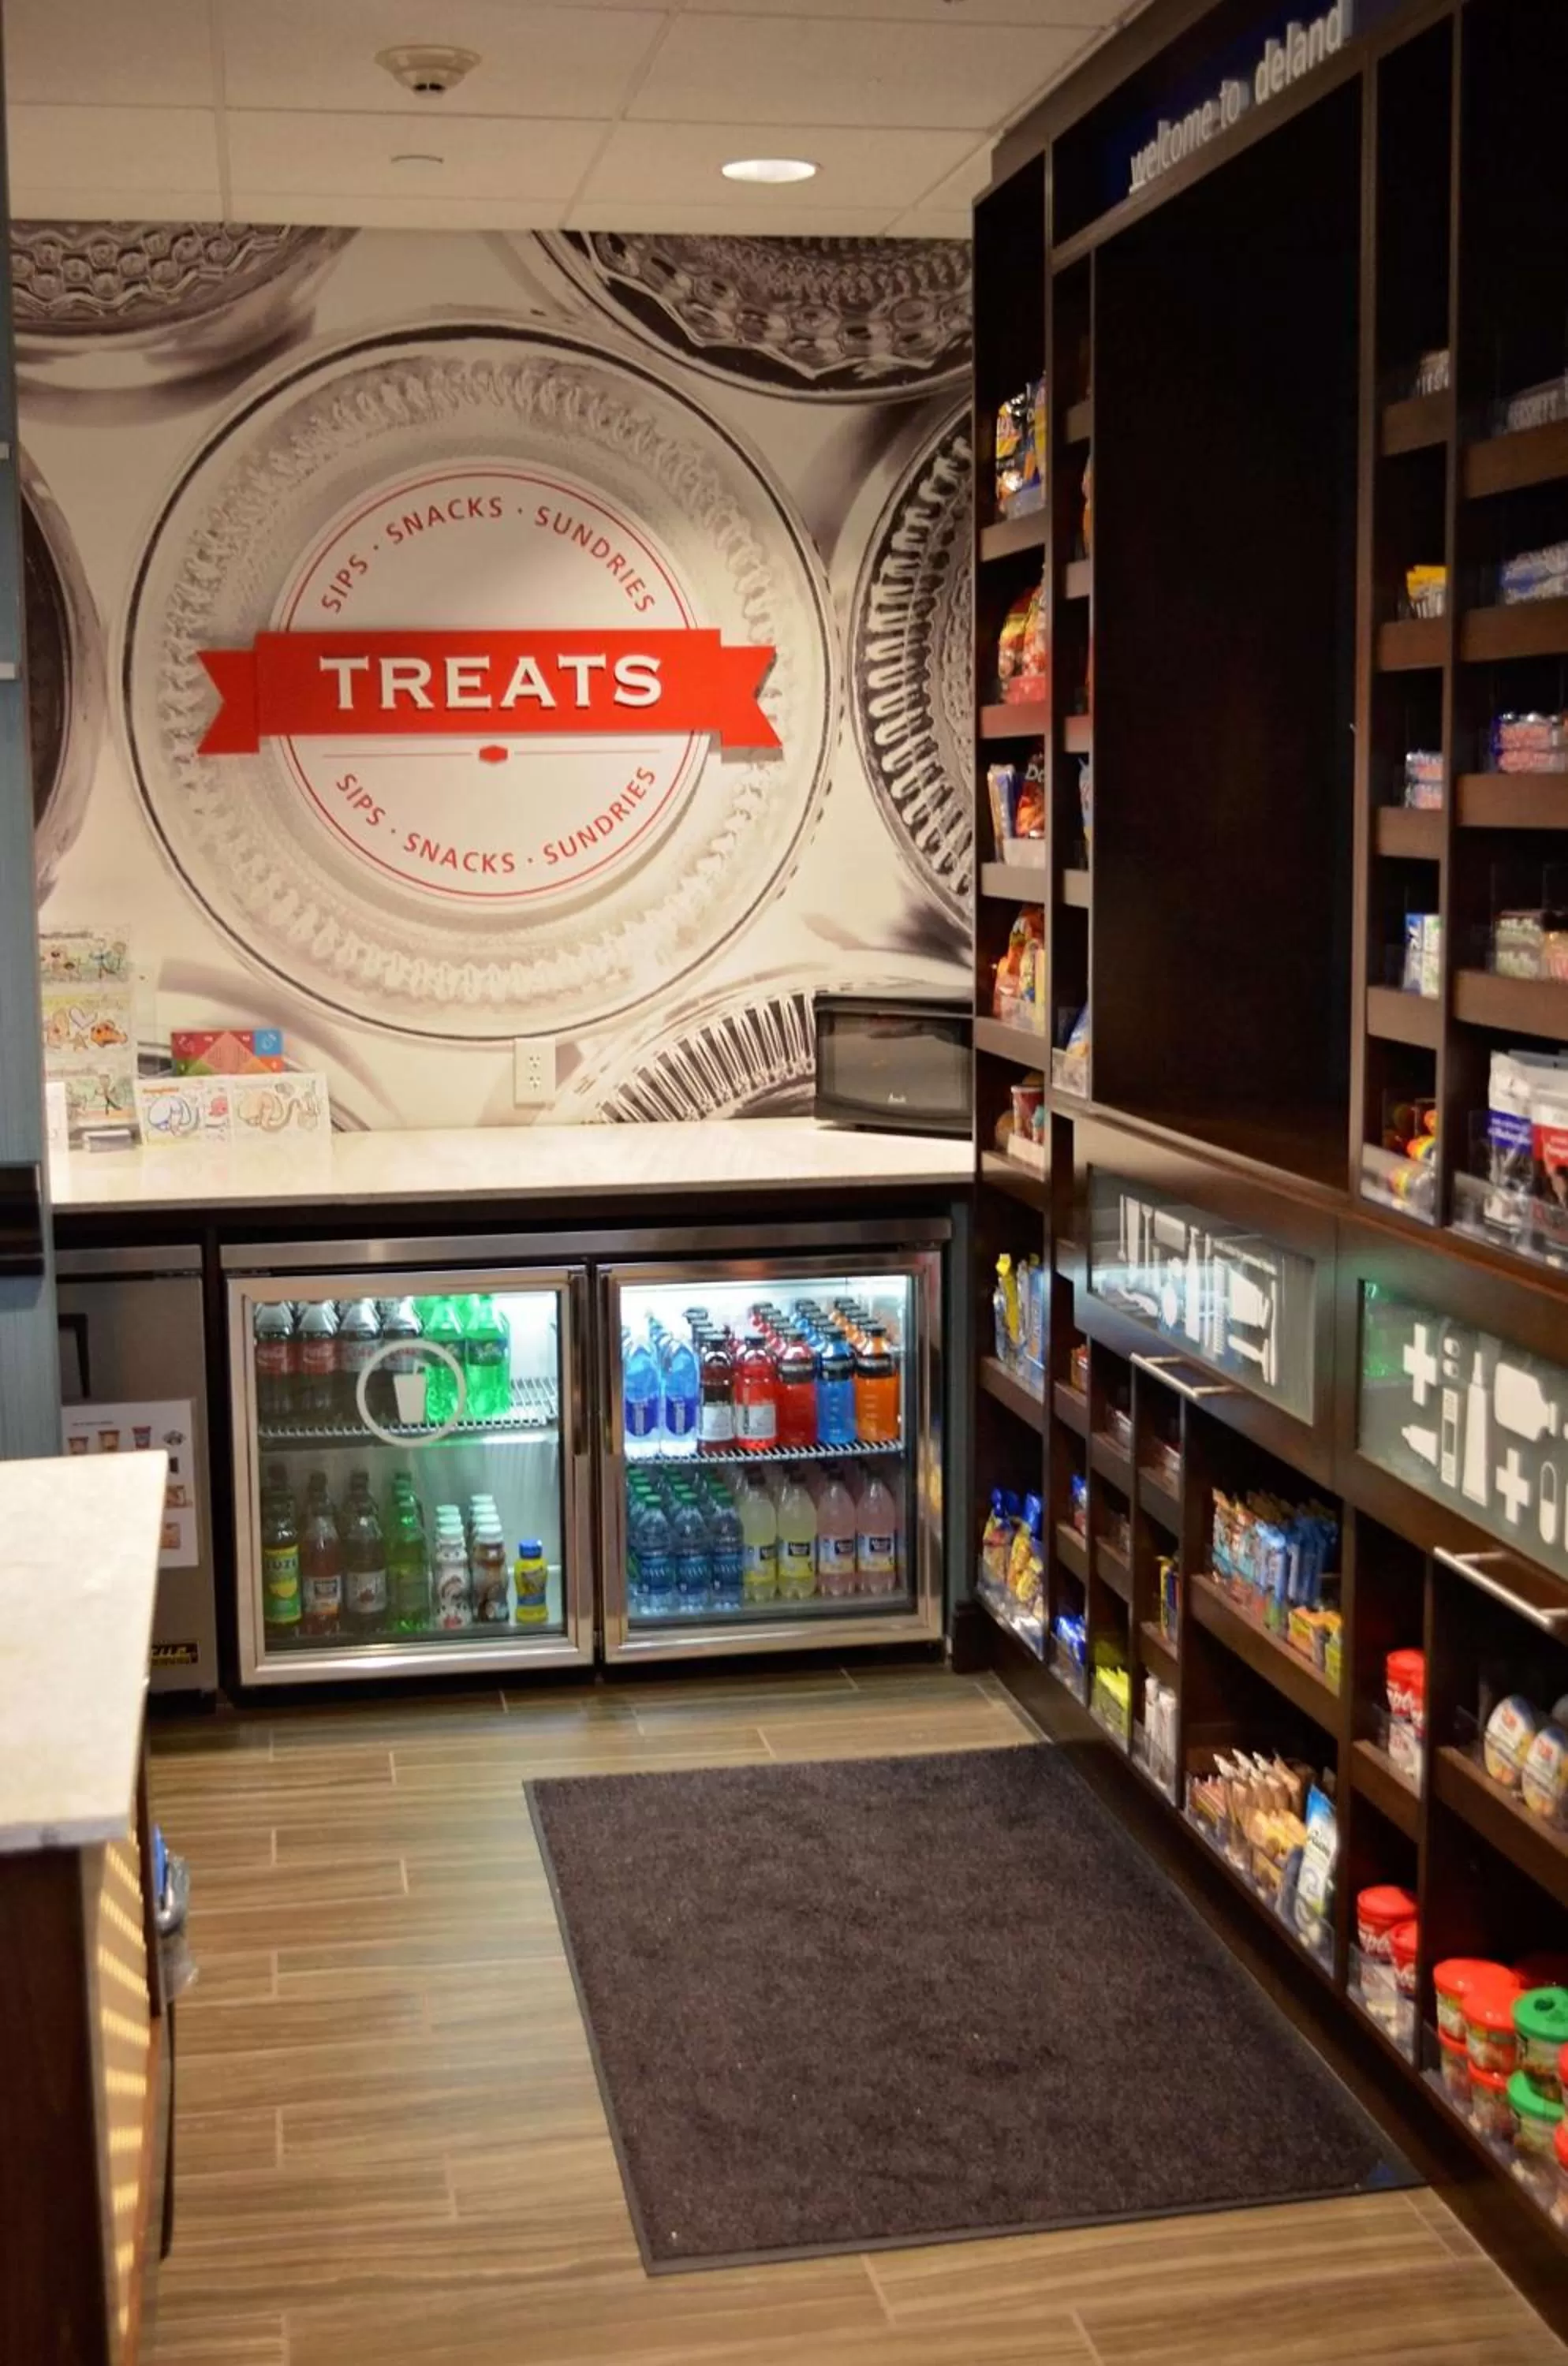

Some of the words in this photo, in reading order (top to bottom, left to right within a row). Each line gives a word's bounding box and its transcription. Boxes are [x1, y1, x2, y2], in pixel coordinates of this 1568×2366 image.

[1129, 99, 1216, 185] welcome
[1219, 80, 1244, 130] to
[321, 554, 368, 614] SIPS
[385, 496, 503, 545] SNACKS
[533, 505, 655, 613] SUNDRIES
[319, 653, 663, 710] TREATS
[335, 773, 386, 827] SIPS
[402, 832, 516, 875] SNACKS
[543, 766, 656, 865] SUNDRIES
